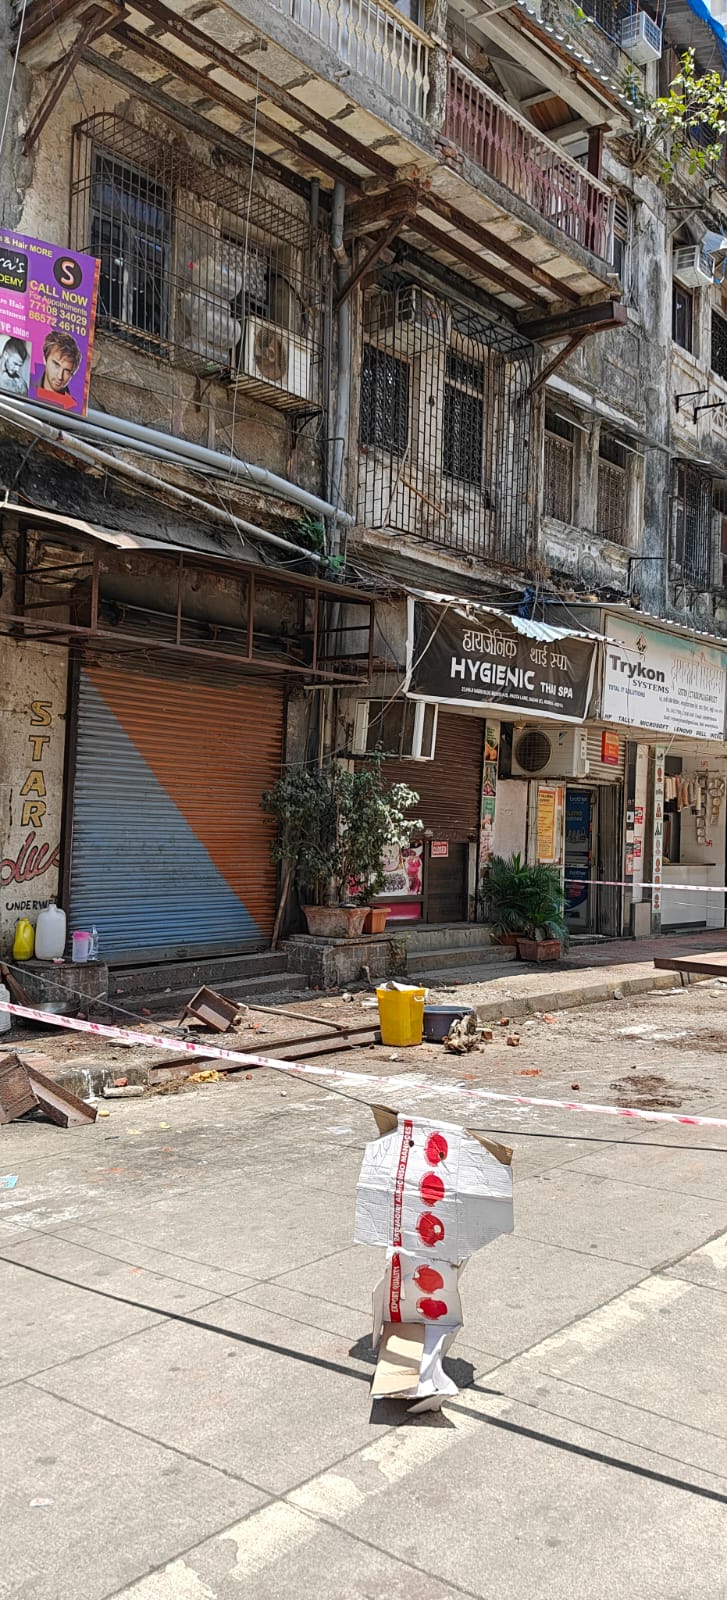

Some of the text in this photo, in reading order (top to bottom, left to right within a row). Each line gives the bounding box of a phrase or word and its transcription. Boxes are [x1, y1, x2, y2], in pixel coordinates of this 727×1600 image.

[12, 239, 28, 250] Hair
[30, 245, 53, 258] MORE
[60, 260, 74, 285] S
[9, 298, 25, 310] Hair
[29, 291, 88, 316] For Appointments
[30, 280, 88, 307] CALL NOW
[30, 300, 87, 326] 77108 34029
[59, 321, 86, 336] 46110
[462, 628, 569, 671] हायजेनिक थाई स्पा
[450, 656, 536, 691] HYGIENIC
[540, 682, 556, 696] THAI
[558, 685, 573, 699] SPA
[609, 654, 665, 683] Trykon
[632, 680, 670, 694] SYSTEMS
[640, 720, 669, 730] MICROSOFT
[674, 726, 693, 735] LENOVO
